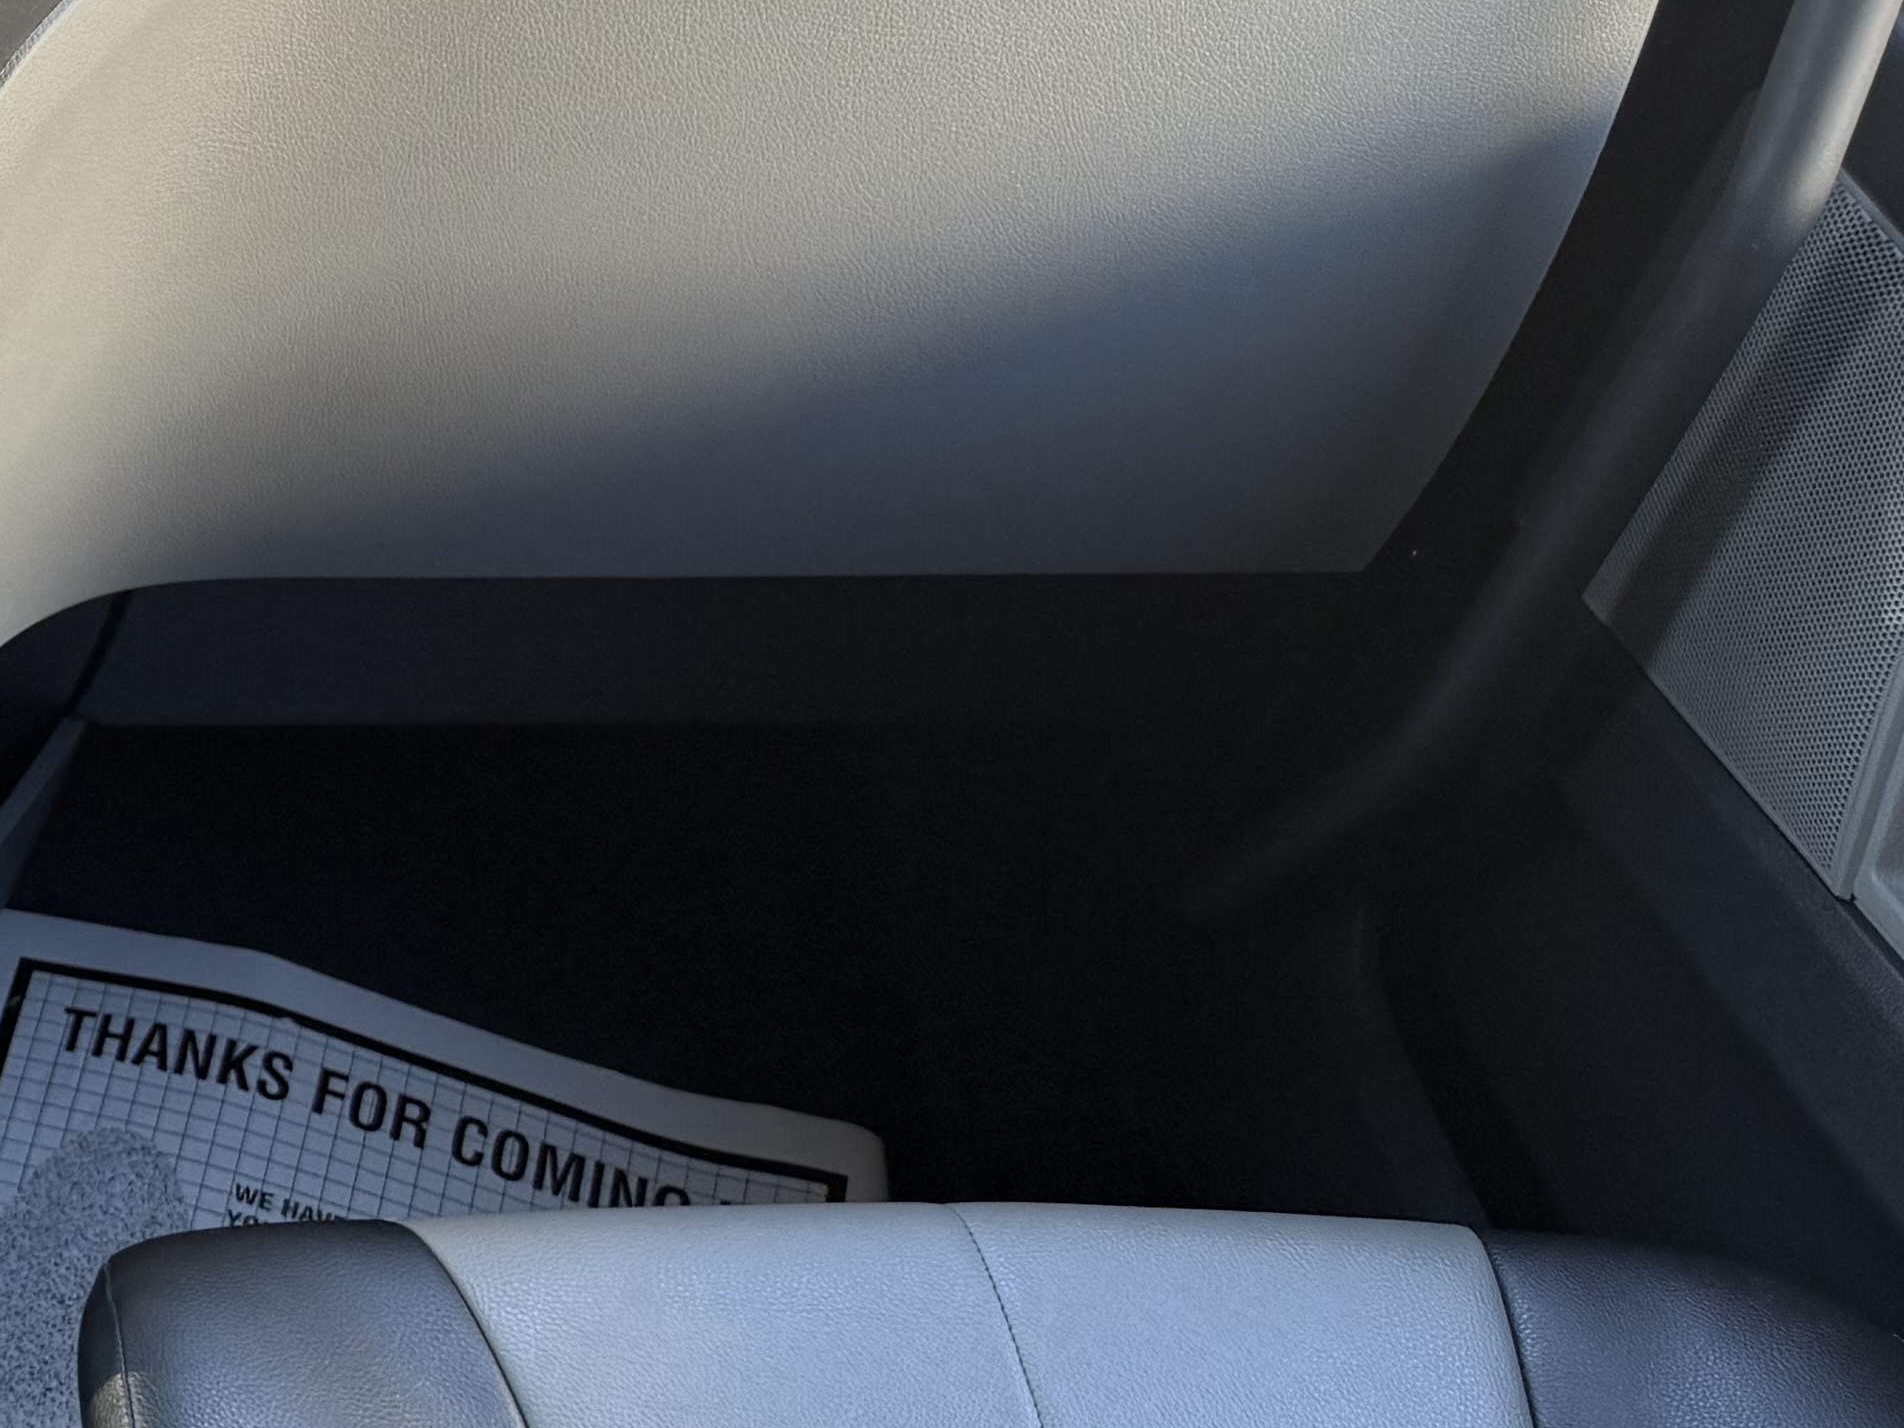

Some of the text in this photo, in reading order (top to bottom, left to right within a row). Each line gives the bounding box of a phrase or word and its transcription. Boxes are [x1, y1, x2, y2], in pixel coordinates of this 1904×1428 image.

[64, 1006, 294, 1101] THANKS
[311, 1066, 432, 1150] FOR
[234, 1182, 274, 1211] WE
